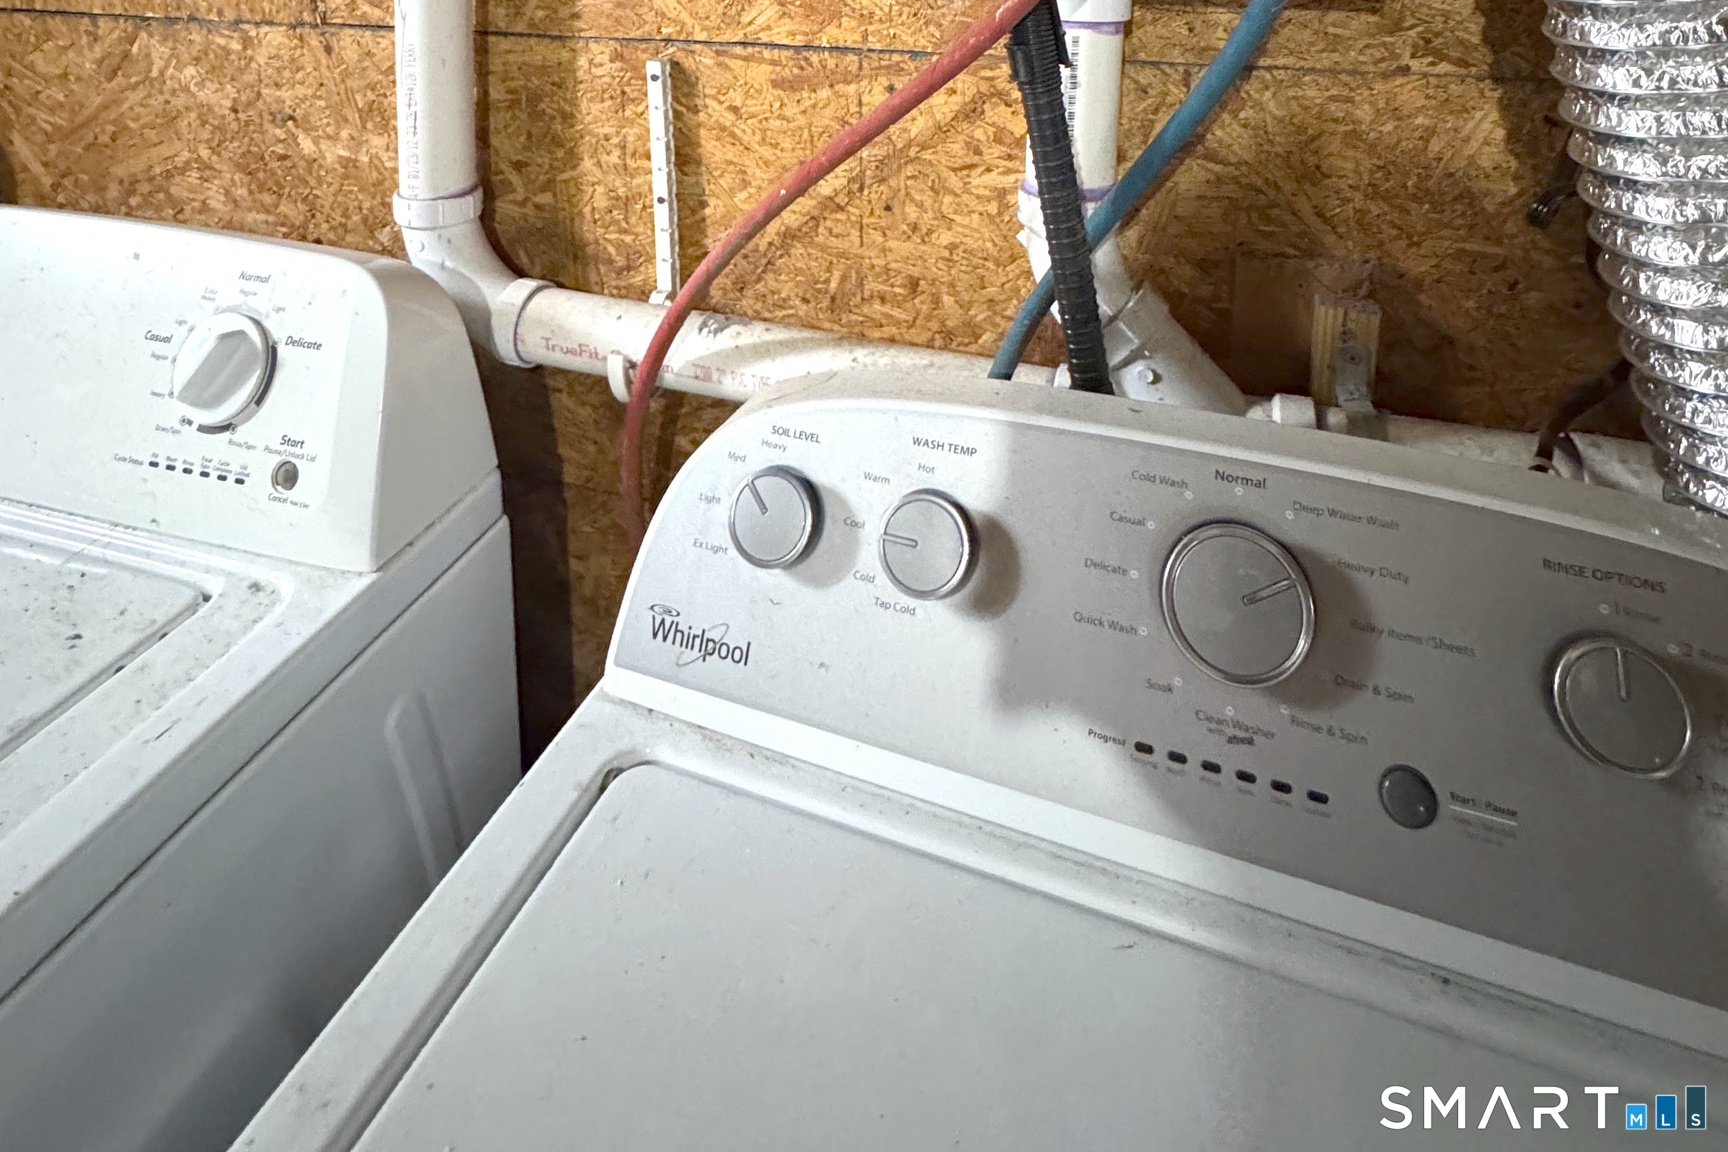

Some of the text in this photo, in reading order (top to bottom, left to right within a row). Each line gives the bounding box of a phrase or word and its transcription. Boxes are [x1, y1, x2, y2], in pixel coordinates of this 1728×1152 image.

[238, 270, 271, 284] Normal
[144, 330, 174, 344] Casual
[284, 335, 322, 351] Delicate
[541, 336, 601, 361] TrueFit
[279, 434, 305, 449] Start
[771, 425, 821, 444] SOIL LEVEL
[761, 438, 788, 452] Heavy
[912, 436, 977, 457] WASH TEMP
[727, 451, 746, 462] Med
[917, 462, 935, 475] Hot
[863, 471, 891, 485] Warm
[1131, 469, 1189, 489] Cold Wash
[1214, 469, 1268, 490] Normal
[268, 492, 289, 504] Cancel
[699, 492, 721, 505] Light
[1292, 500, 1325, 517] Deep
[843, 516, 866, 530] Cool
[1109, 510, 1146, 527] Casual
[693, 538, 728, 556] Ex Light
[1084, 557, 1129, 577] Delicate
[1337, 558, 1410, 585] Heavy Duty
[1542, 557, 1667, 594] RINSE OPTIONS
[853, 569, 876, 584] Cold
[874, 597, 916, 616] Tap Cold
[1072, 611, 1138, 636] Quick Wash
[651, 614, 752, 667] Whirlpool
[1147, 678, 1174, 695] Soak
[1195, 709, 1230, 729] Clean
[1088, 728, 1127, 747] Progress
